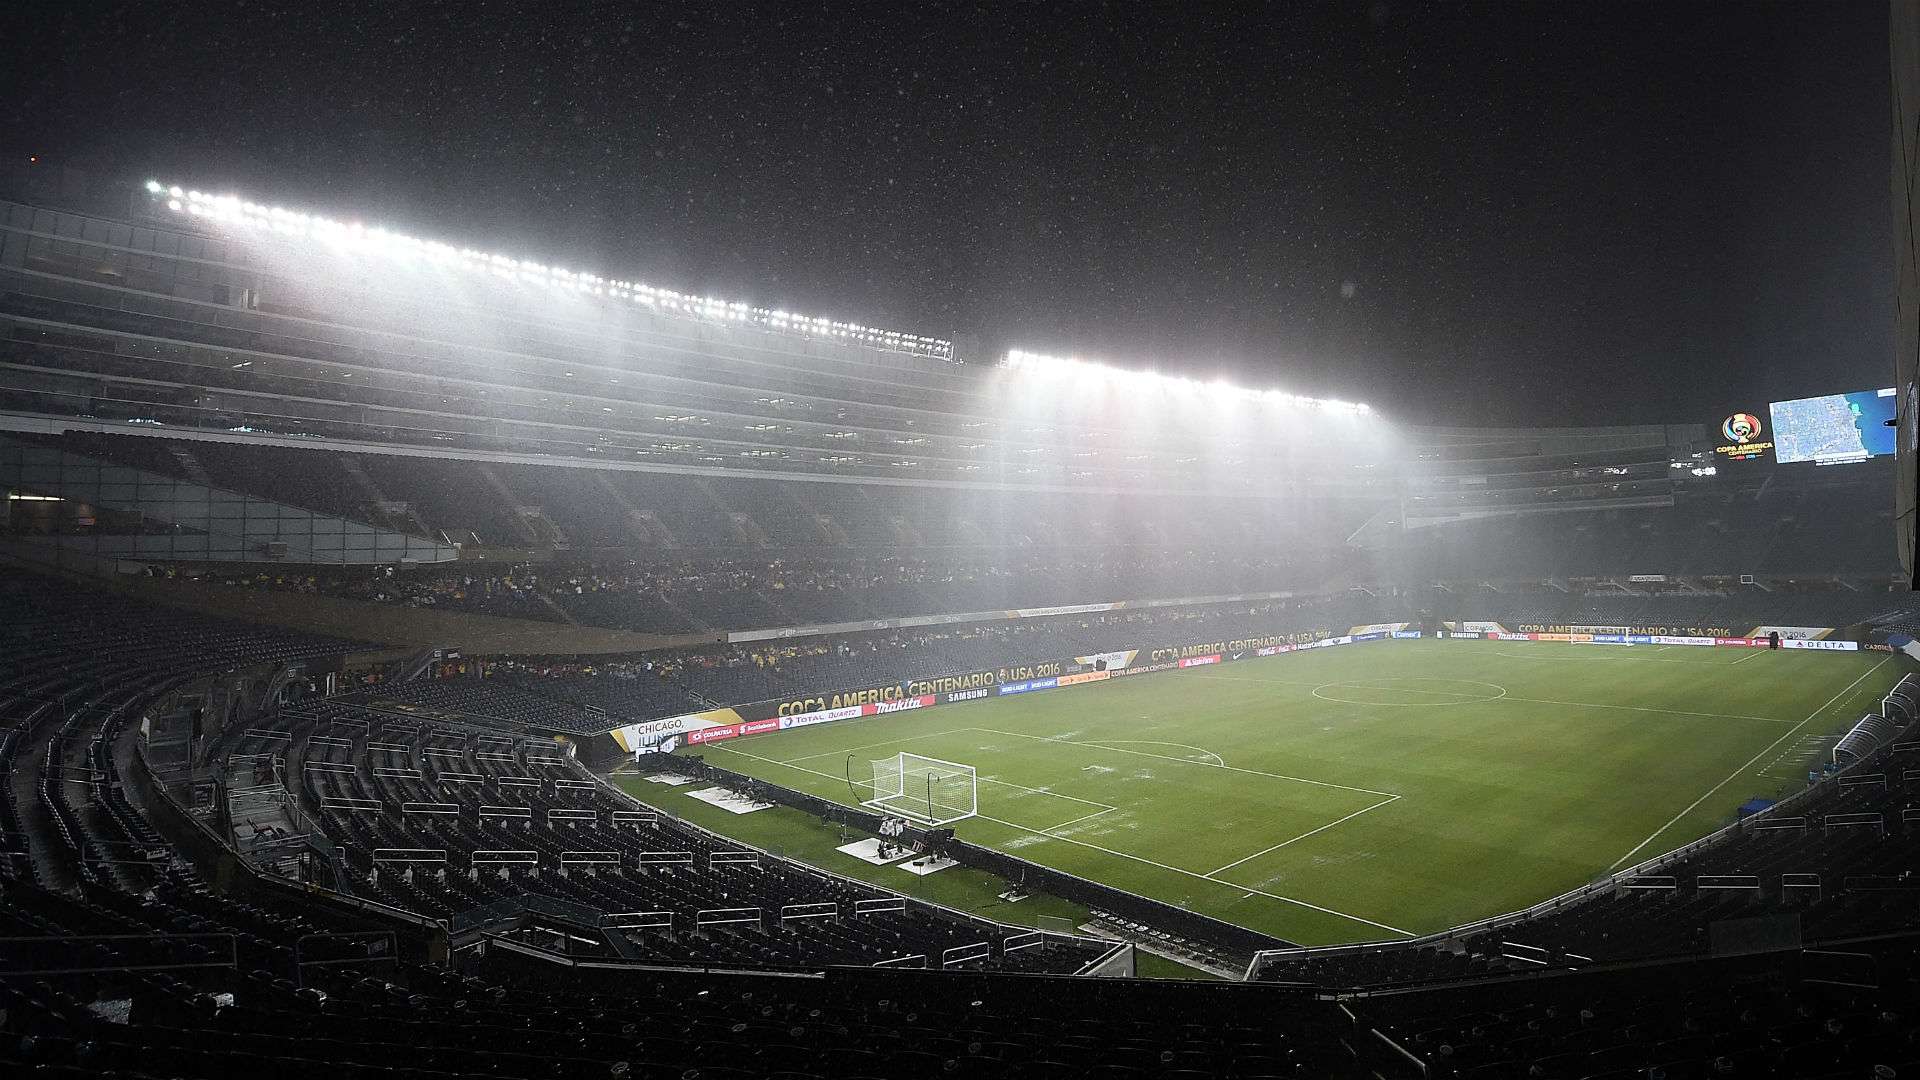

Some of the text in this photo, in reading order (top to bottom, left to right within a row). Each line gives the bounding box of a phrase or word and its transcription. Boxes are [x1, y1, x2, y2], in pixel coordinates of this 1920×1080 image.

[1739, 442, 1773, 451] AMERICA
[1518, 624, 1545, 633] COPA
[1548, 625, 1595, 634] AMERICA
[1598, 626, 1668, 636] CENTENARIO
[1707, 628, 1731, 637] 2016
[1181, 642, 1227, 658] AMERICA
[1228, 635, 1286, 651] CENTENARIO
[1296, 633, 1314, 643] USA
[1807, 640, 1845, 649] DELTA
[831, 685, 904, 709] AMERICA
[908, 671, 994, 696] CENTENARIO
[1011, 667, 1035, 681] USA
[1037, 663, 1061, 677] 2016
[948, 689, 988, 702] SAMSUNG
[875, 696, 923, 714] Makita
[796, 709, 857, 723] TOTAL QUARTZ
[638, 719, 684, 735] CHICAGO,
